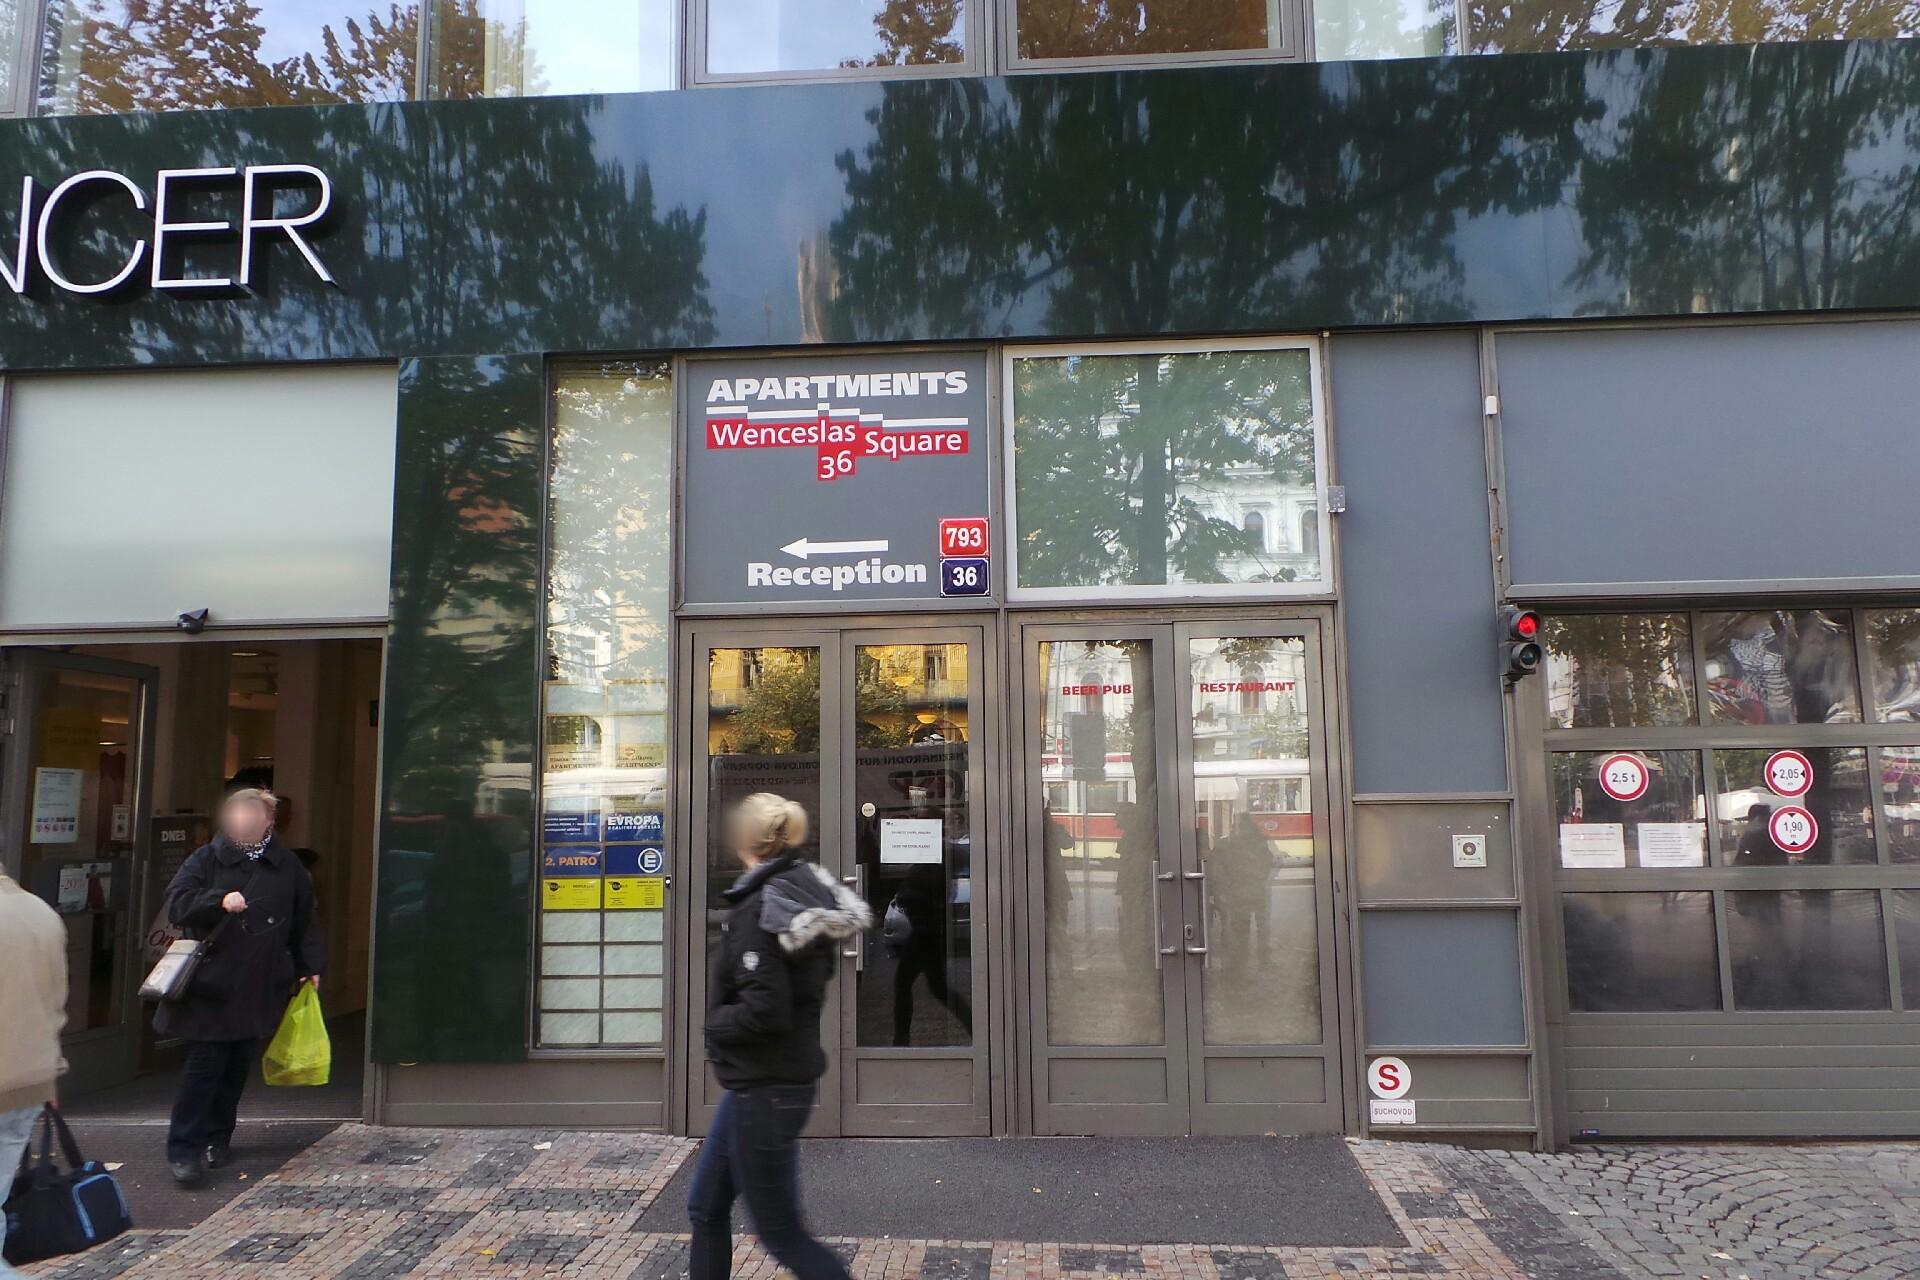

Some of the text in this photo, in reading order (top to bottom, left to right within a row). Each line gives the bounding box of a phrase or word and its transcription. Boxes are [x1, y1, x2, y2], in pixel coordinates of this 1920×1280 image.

[706, 371, 968, 402] APARTMENTS
[711, 419, 962, 458] Wenceslas Square
[820, 450, 853, 479] 36
[945, 527, 982, 548] 793
[747, 558, 927, 591] Reception
[952, 566, 977, 587] 36
[1062, 684, 1132, 696] BEER PUB
[1200, 682, 1296, 693] RESTAURANT
[1611, 772, 1629, 784] 2,5
[1779, 768, 1799, 780] 2,05
[607, 815, 660, 826] EVROPA
[1783, 821, 1803, 834] 1,90
[161, 830, 186, 842] DNES
[545, 856, 598, 867] 2. PATRO
[1378, 1064, 1400, 1091] S
[1374, 1107, 1413, 1116] SUCHOVOD
